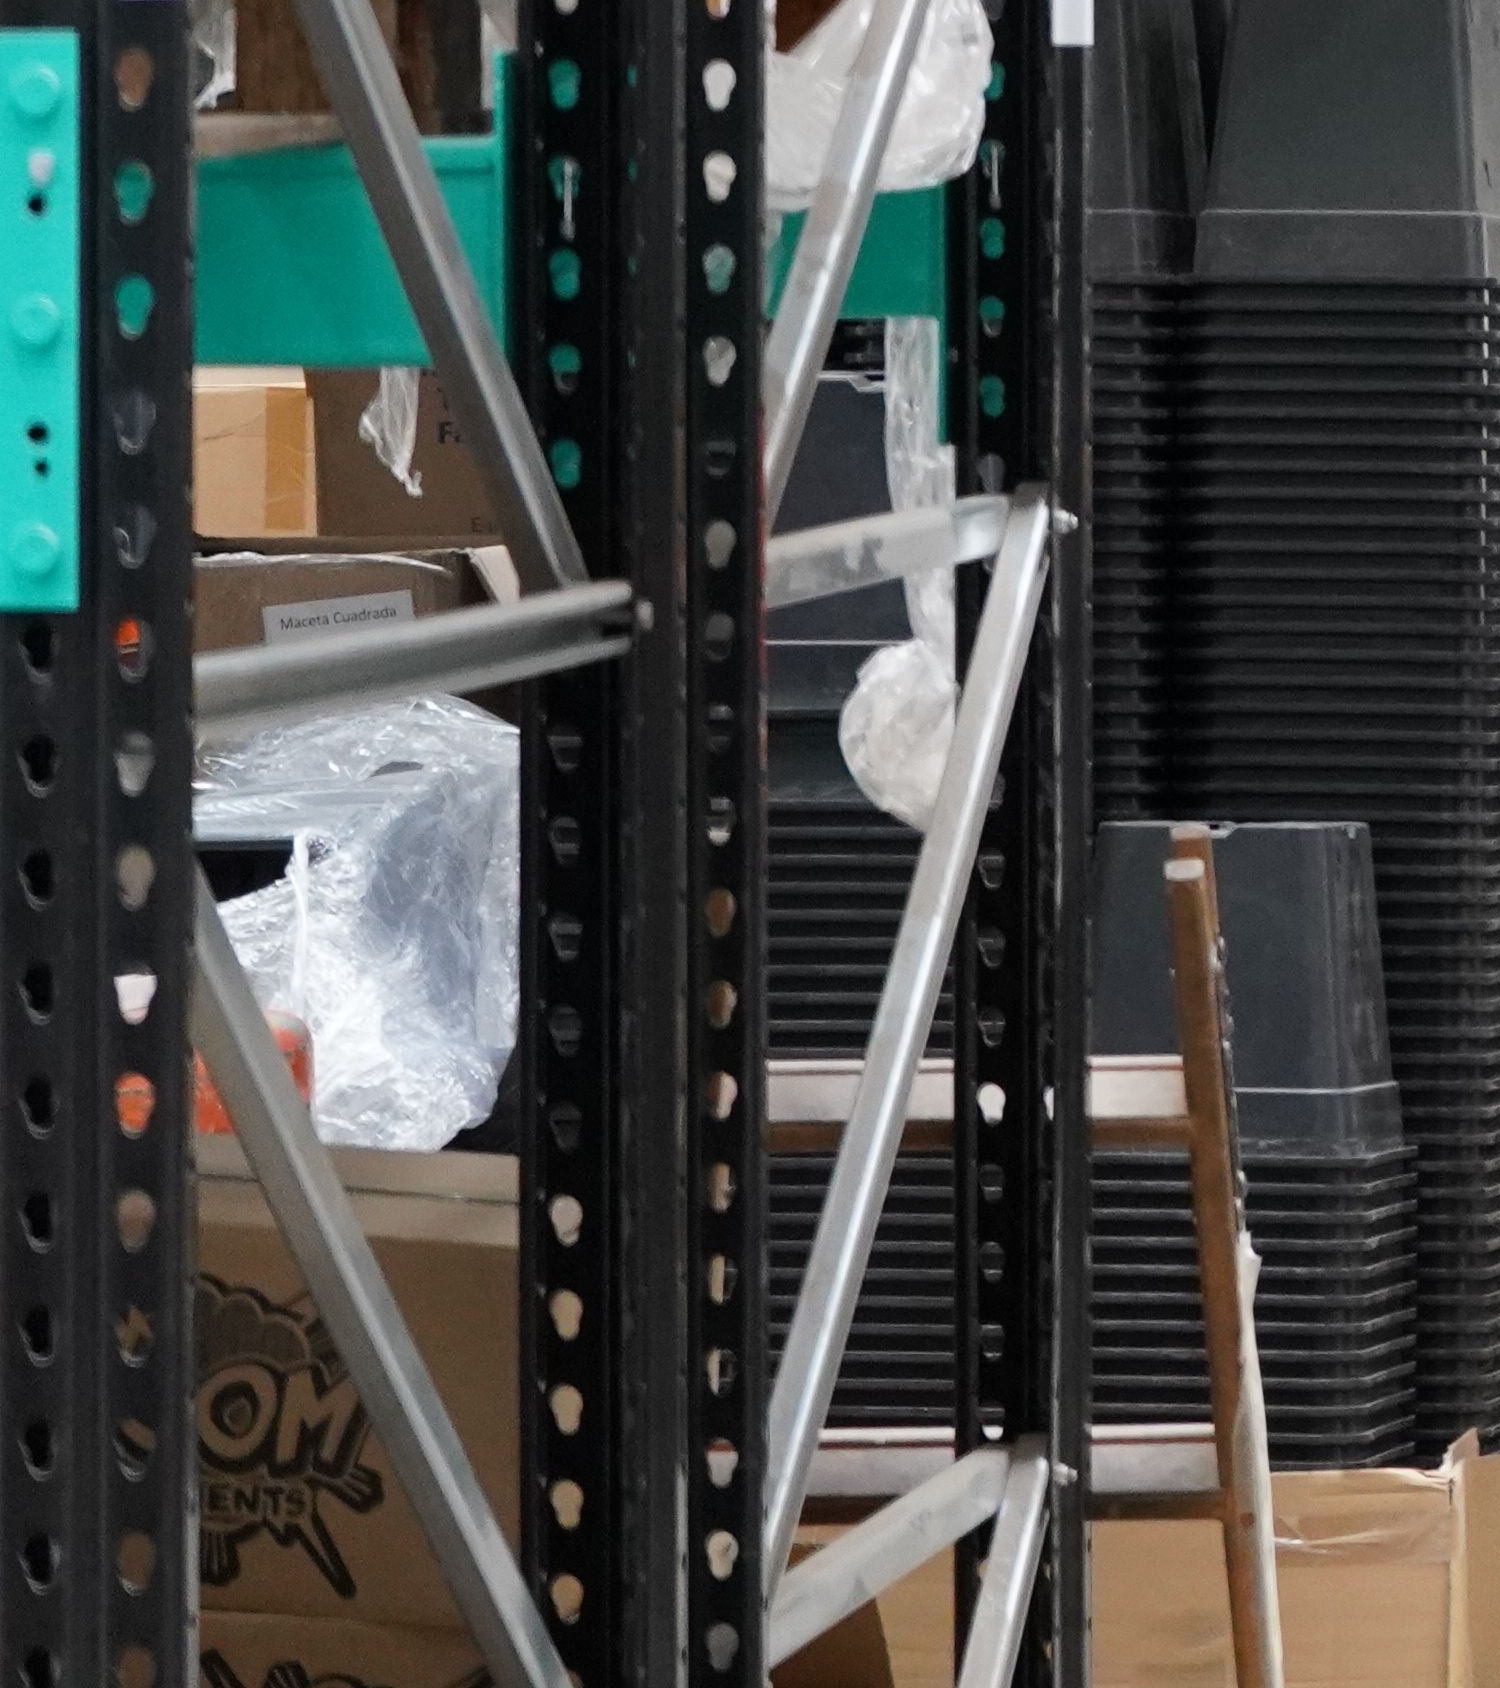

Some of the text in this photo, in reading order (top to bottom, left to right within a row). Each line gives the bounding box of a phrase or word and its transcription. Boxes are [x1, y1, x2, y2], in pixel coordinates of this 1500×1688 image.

[280, 604, 397, 631] Maceta Cuadrada
[198, 1364, 367, 1478] OM
